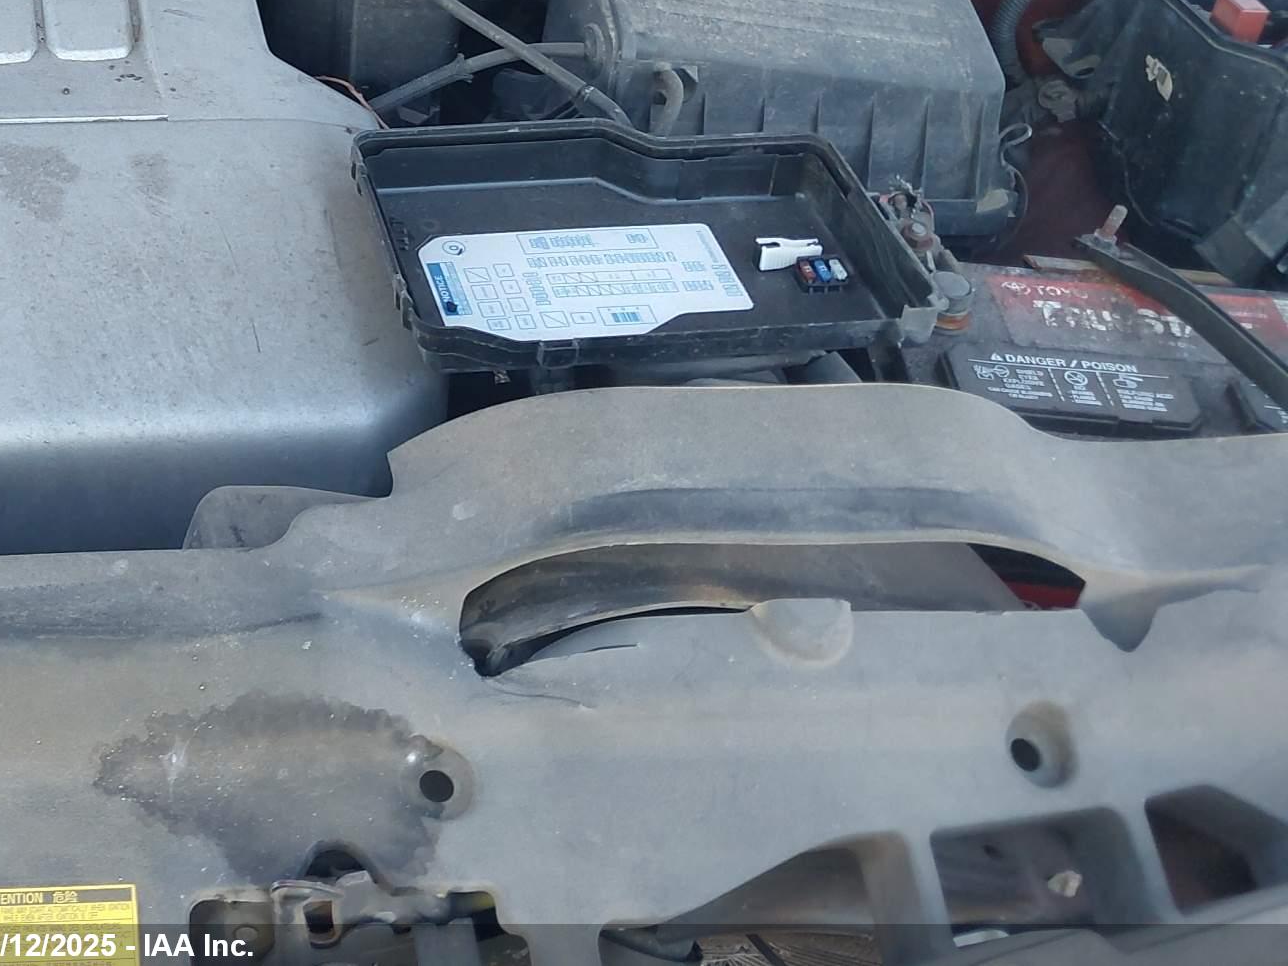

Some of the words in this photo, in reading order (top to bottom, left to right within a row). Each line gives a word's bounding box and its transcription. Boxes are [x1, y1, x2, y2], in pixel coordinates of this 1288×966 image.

[1005, 353, 1066, 368] DANGER
[1069, 359, 1078, 369] /
[1082, 360, 1138, 374] POISON
